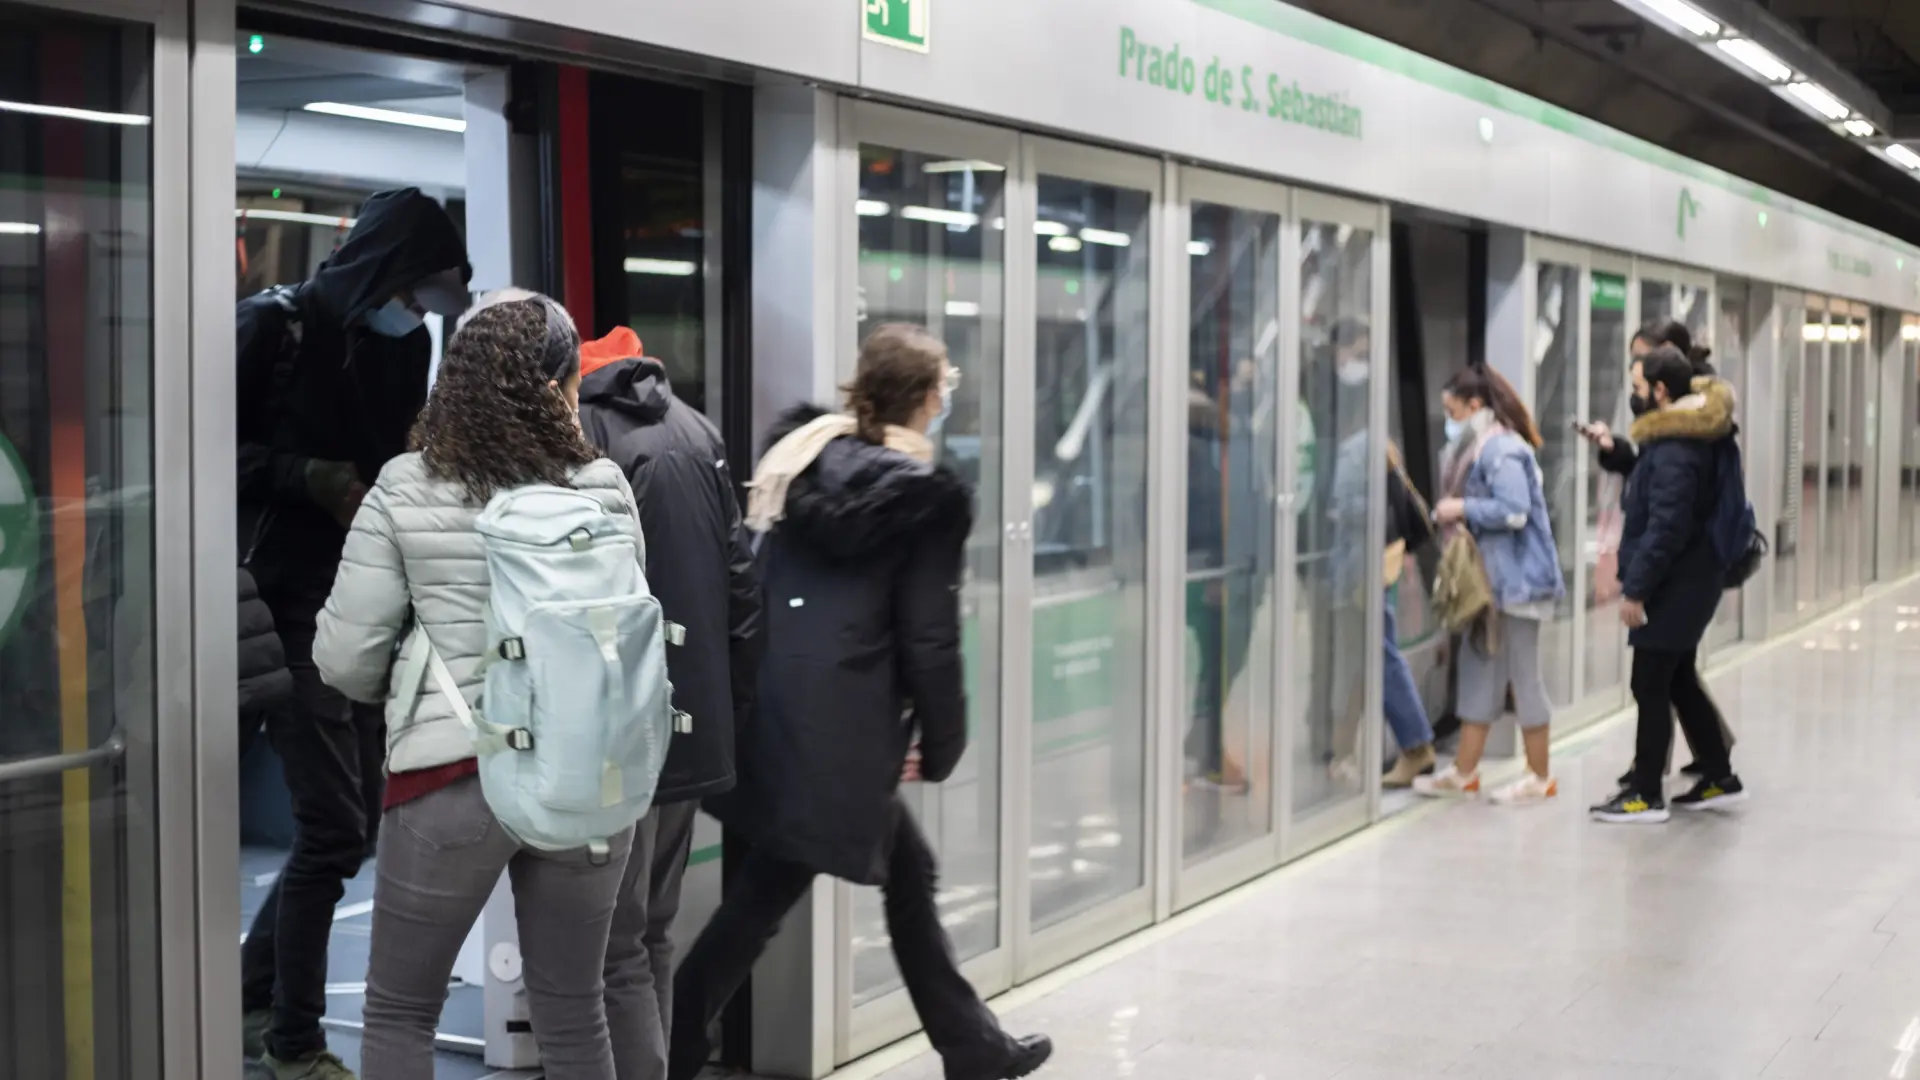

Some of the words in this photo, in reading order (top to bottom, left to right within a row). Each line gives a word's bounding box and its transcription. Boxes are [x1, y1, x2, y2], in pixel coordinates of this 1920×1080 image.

[1118, 26, 1195, 95] Prado
[1203, 55, 1233, 106] de
[1240, 65, 1260, 112] S.
